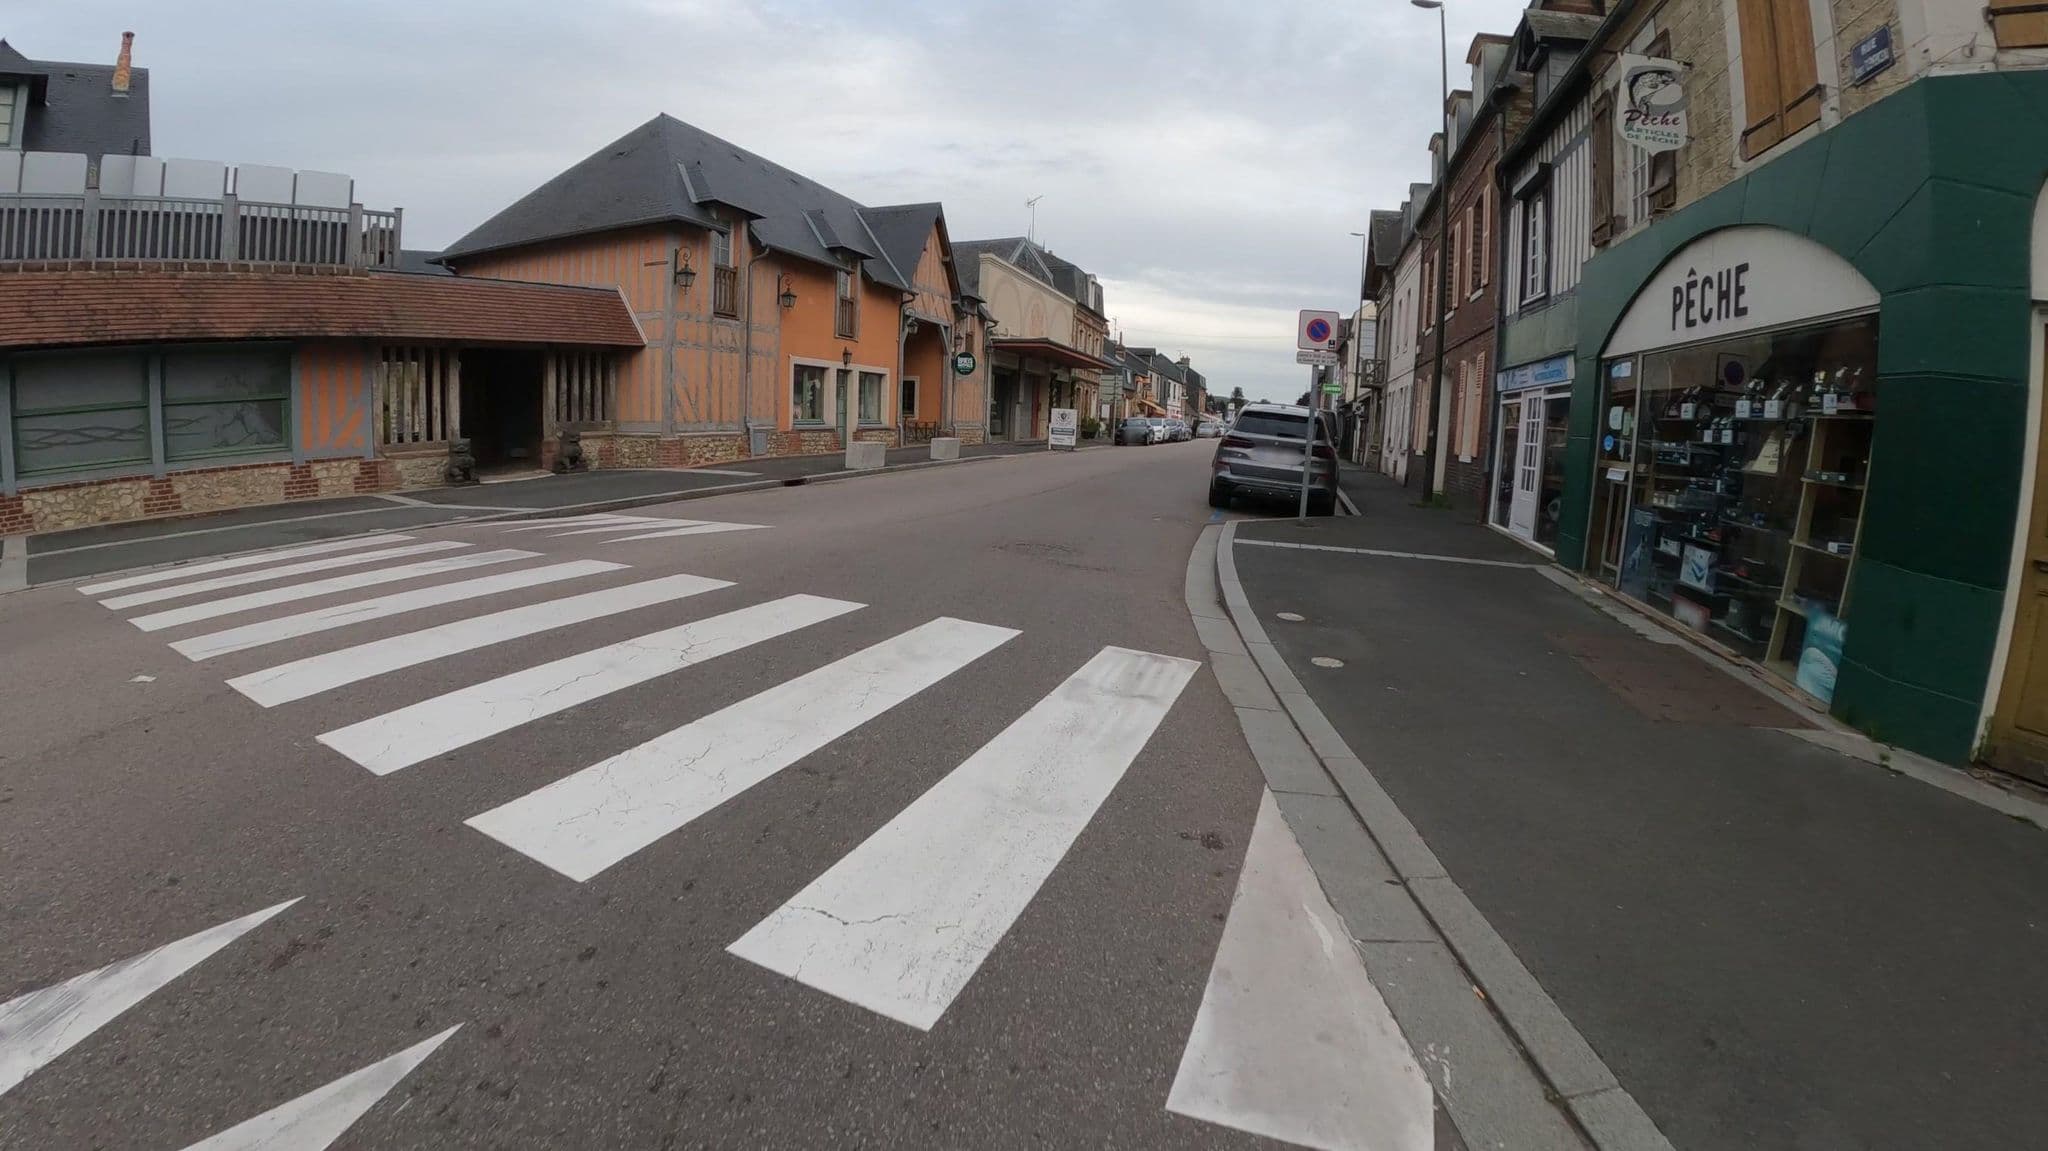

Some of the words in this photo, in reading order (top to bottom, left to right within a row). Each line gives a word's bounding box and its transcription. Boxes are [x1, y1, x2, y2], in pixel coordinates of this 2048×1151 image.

[1861, 37, 1877, 55] RUE
[1628, 127, 1679, 138] ARTICLES
[1672, 262, 1749, 331] PÊCHE
